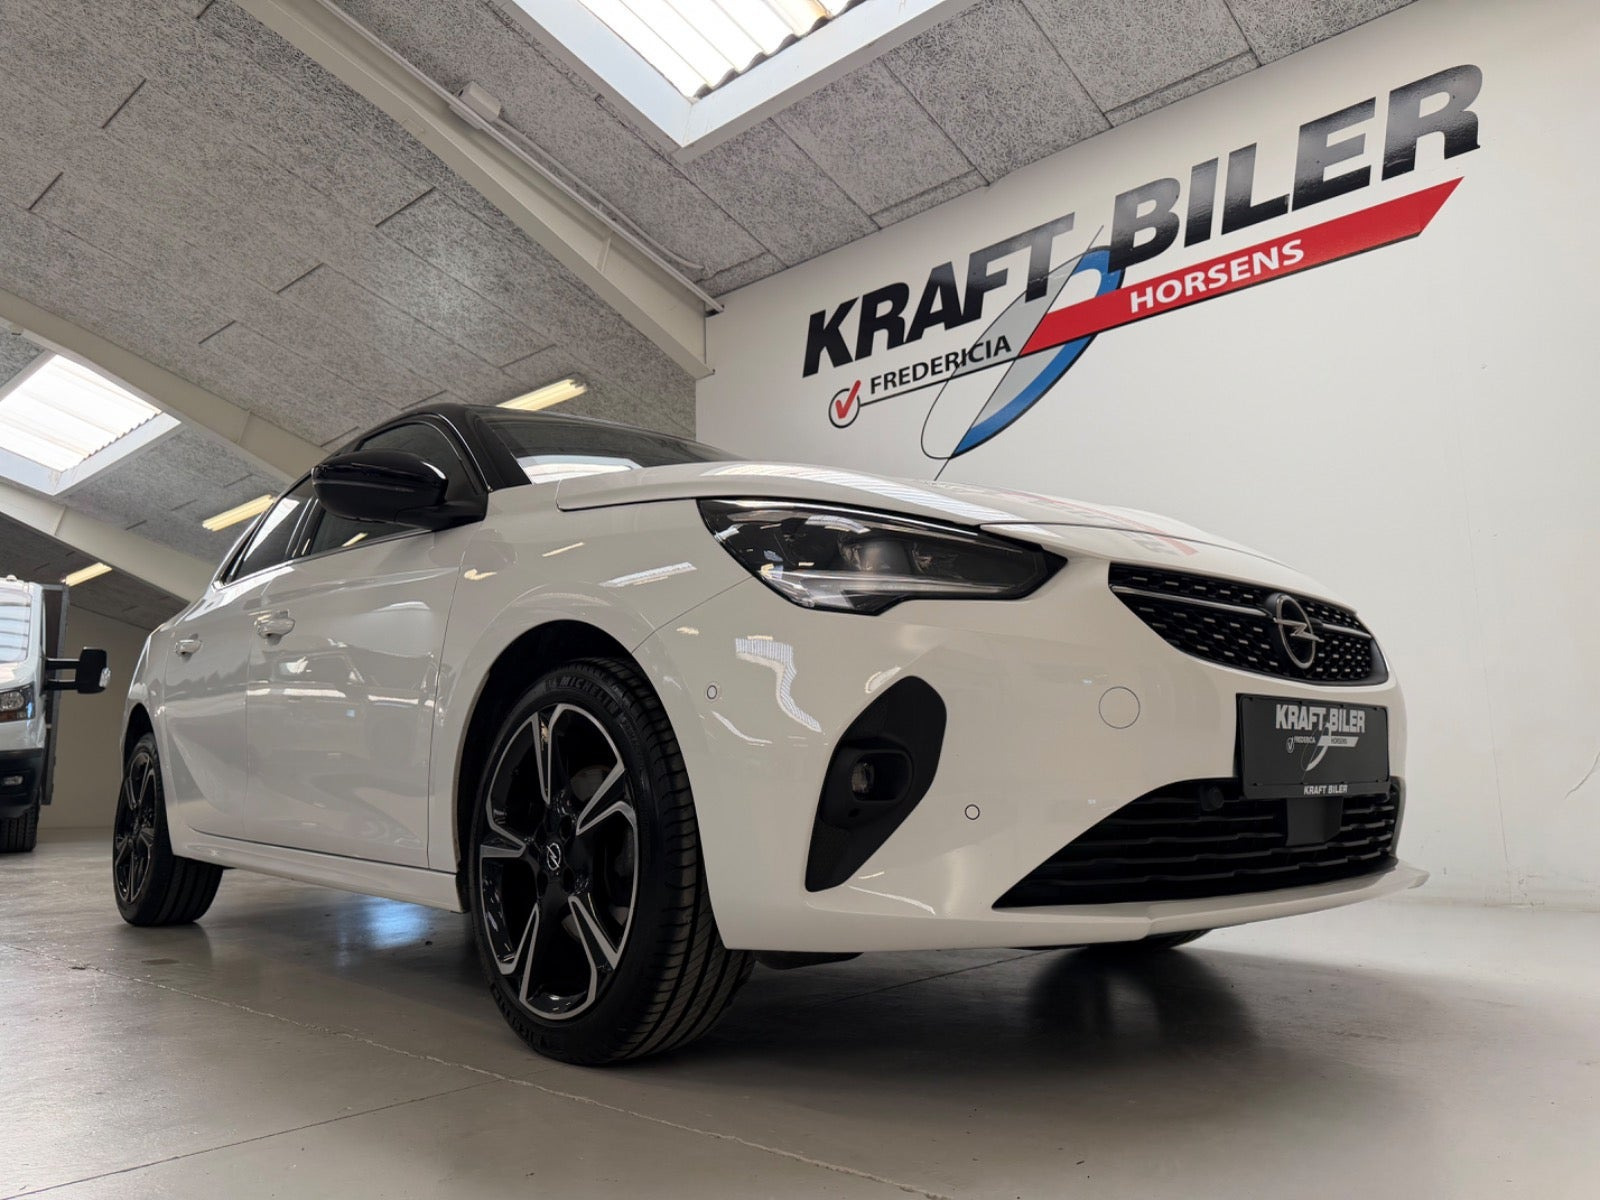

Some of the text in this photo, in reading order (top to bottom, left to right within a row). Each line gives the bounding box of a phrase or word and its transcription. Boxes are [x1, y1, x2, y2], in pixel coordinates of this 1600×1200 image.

[802, 64, 1483, 378] KRAFT BILER
[1130, 239, 1305, 314] HORSENS
[870, 335, 1012, 394] FREDERICIA
[1275, 704, 1366, 733] KRAFT BILER
[1303, 784, 1348, 796] KRAFT BILER
